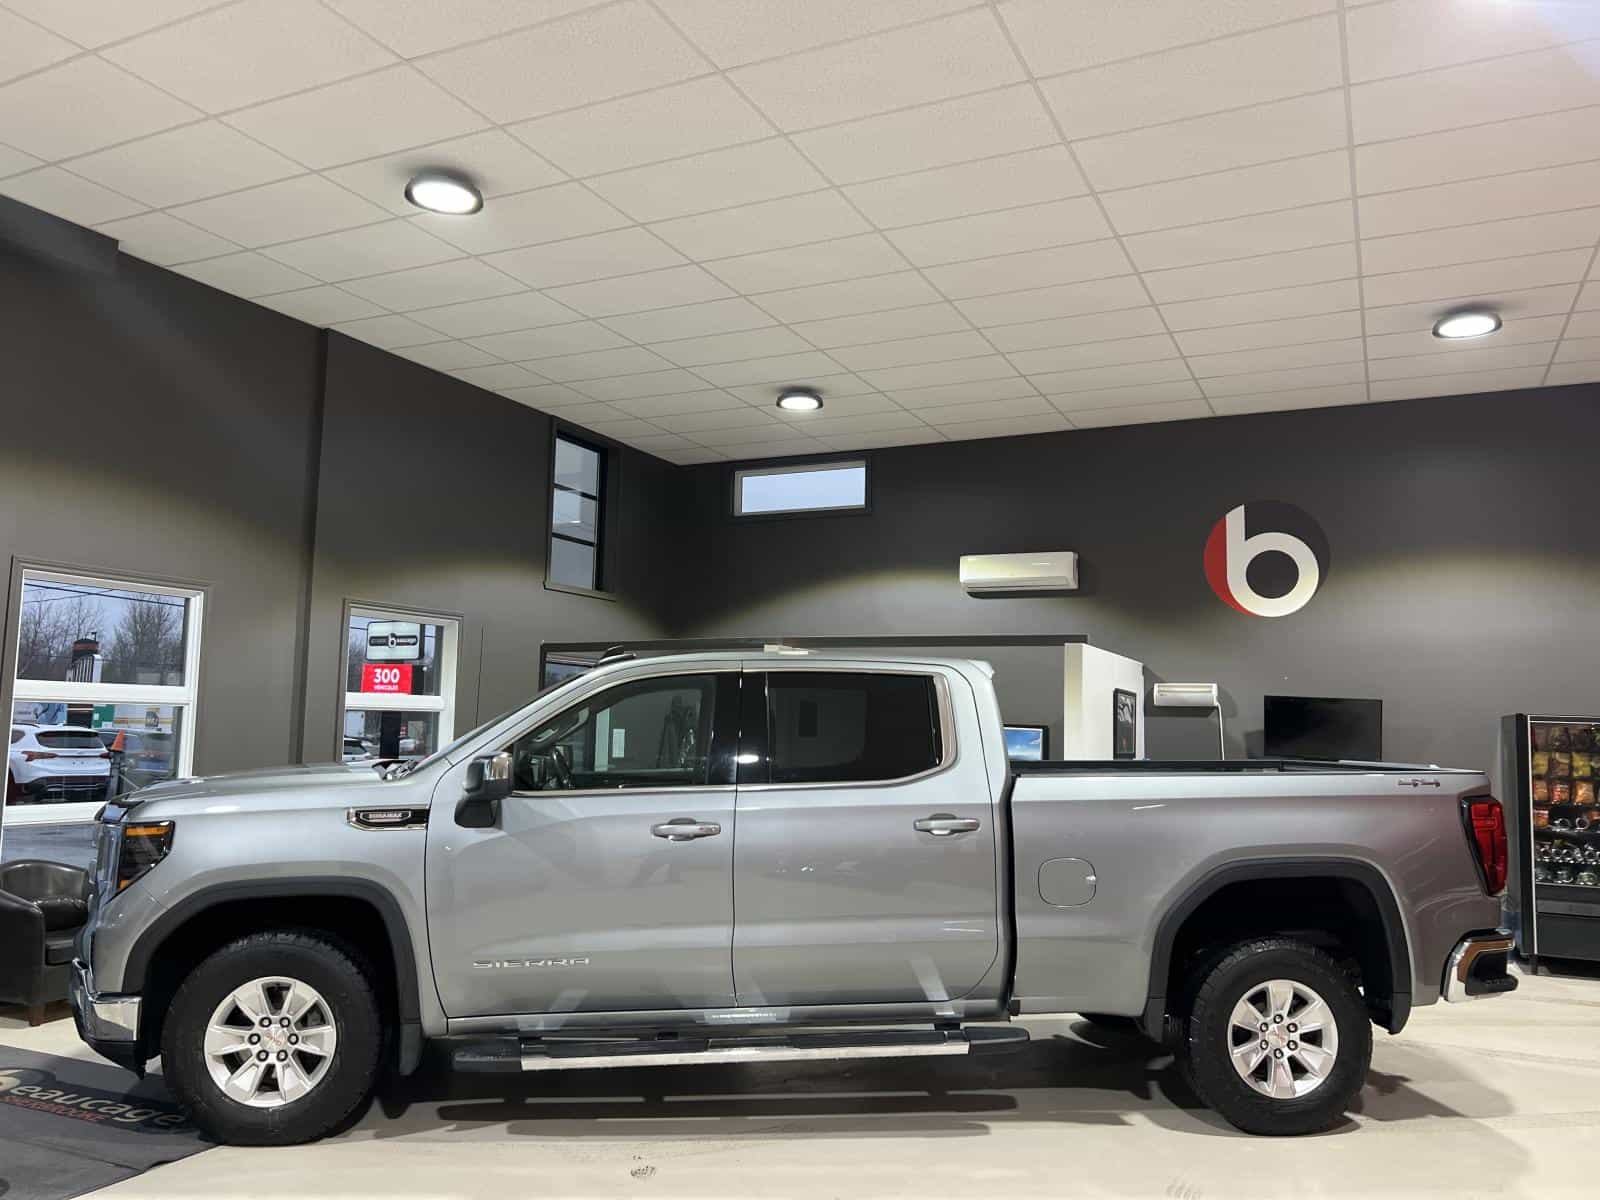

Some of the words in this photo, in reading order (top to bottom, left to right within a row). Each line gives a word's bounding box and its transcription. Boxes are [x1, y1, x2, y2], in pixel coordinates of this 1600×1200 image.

[1225, 504, 1319, 617] b
[374, 668, 400, 683] 300
[472, 958, 590, 969] SIERRA
